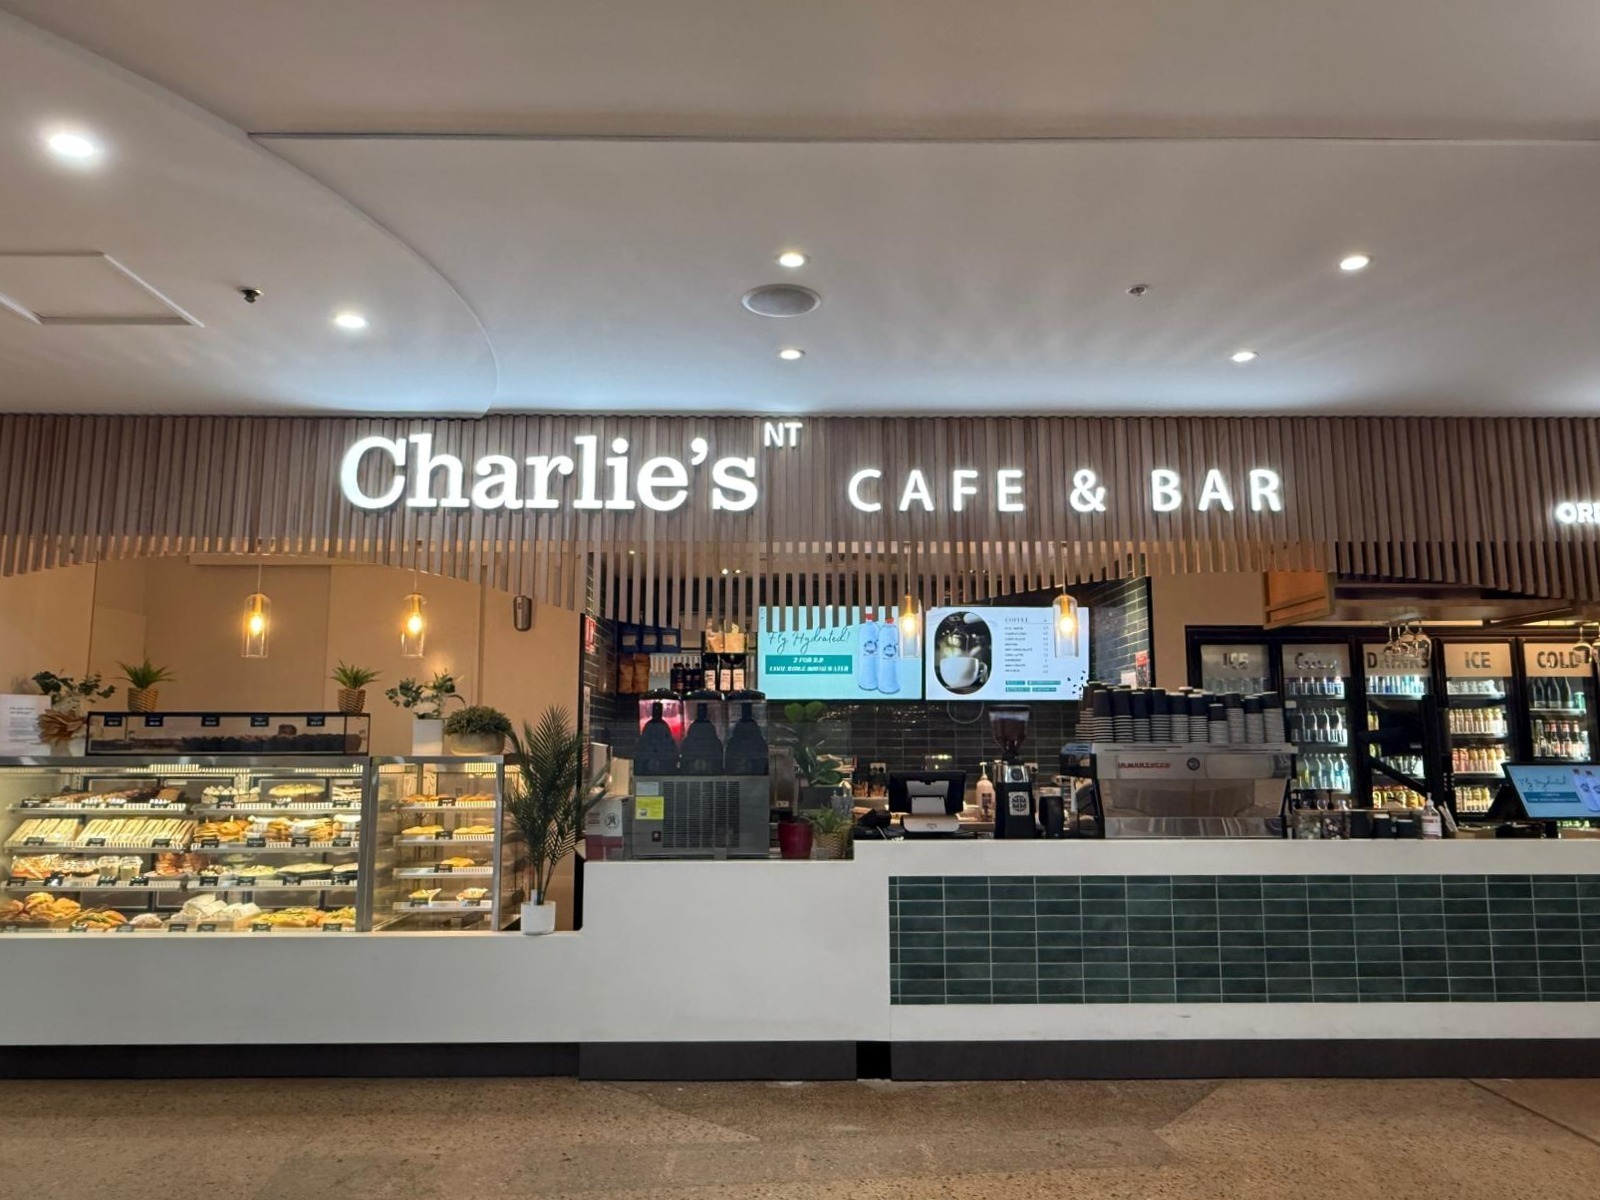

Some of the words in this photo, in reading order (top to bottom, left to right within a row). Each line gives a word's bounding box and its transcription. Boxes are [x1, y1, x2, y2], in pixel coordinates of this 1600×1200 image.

[339, 432, 760, 513] Charlie's
[763, 421, 803, 448] NT
[847, 467, 1025, 513] CAFE
[1069, 467, 1107, 513] &
[1150, 467, 1283, 513] BAR
[1464, 651, 1492, 669] ICE
